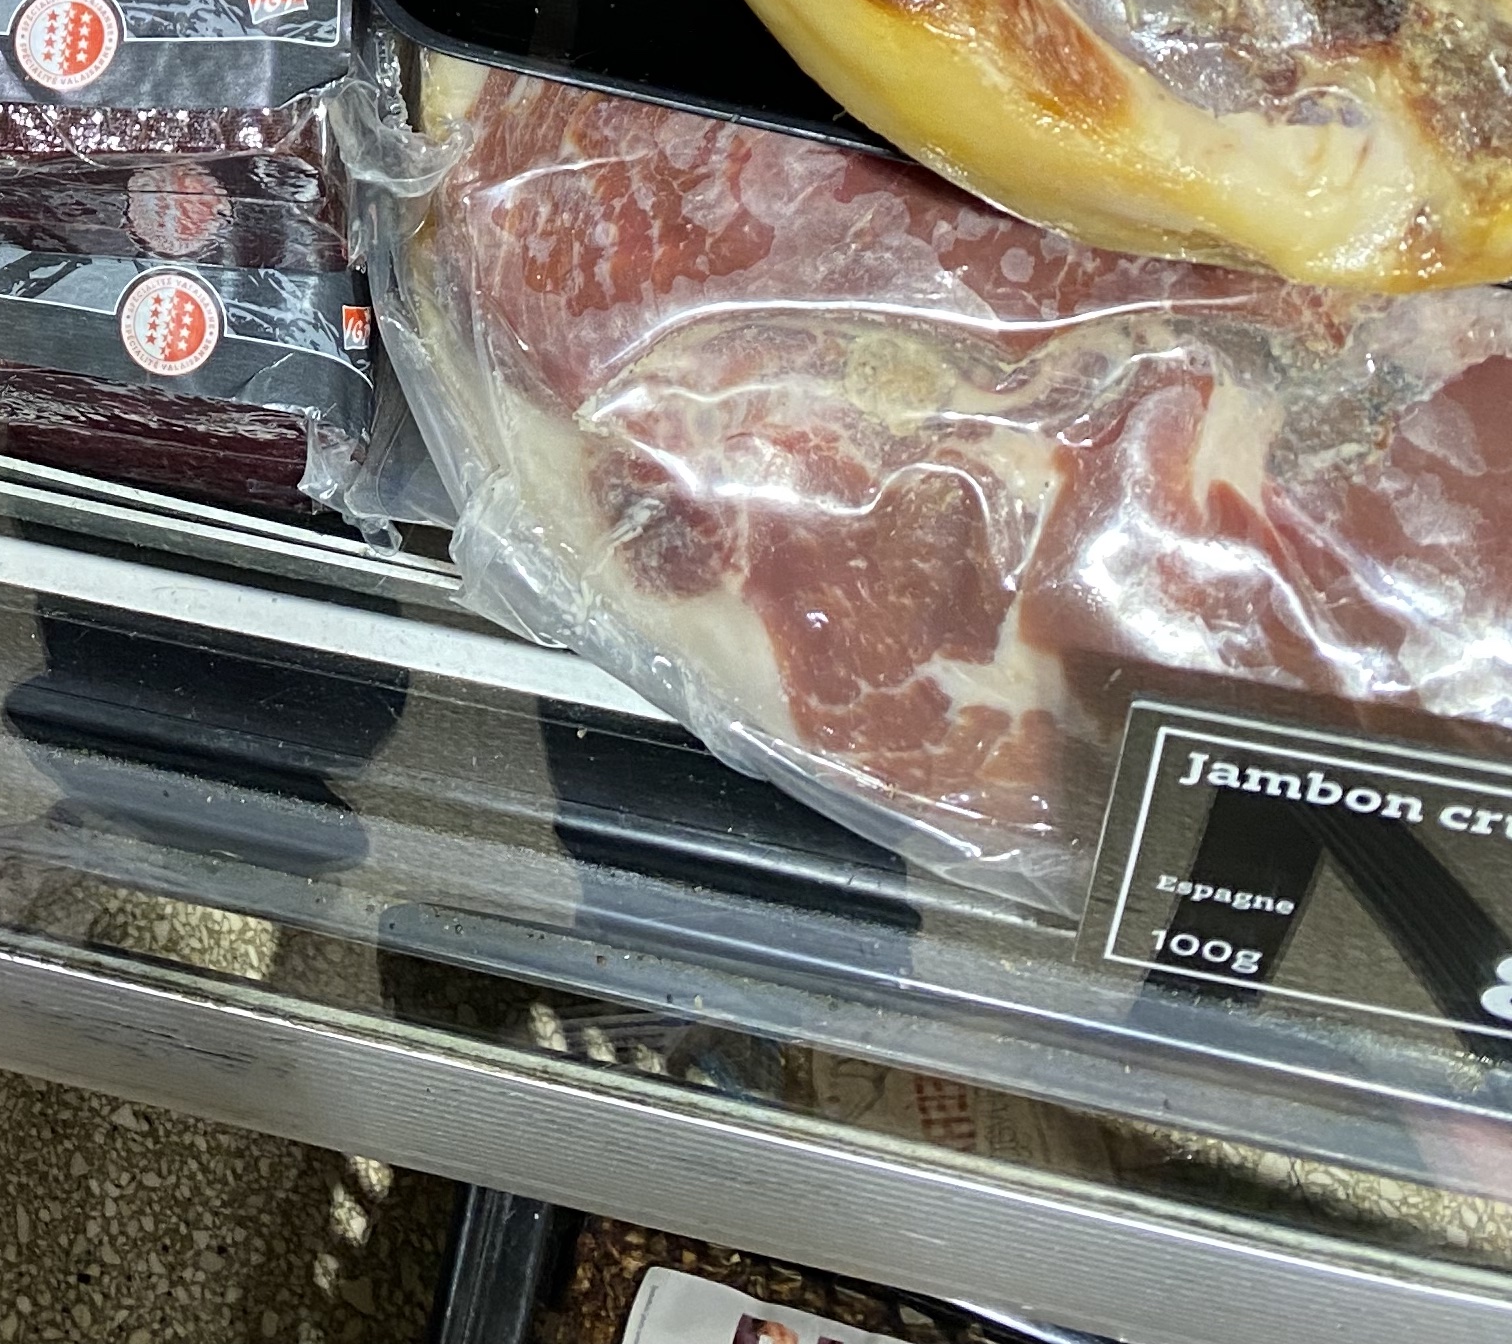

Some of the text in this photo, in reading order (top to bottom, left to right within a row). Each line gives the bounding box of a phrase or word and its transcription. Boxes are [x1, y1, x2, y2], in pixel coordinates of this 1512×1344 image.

[1178, 752, 1424, 824] Jambon
[1156, 875, 1296, 915] Espagne
[1150, 928, 1264, 975] 100g
